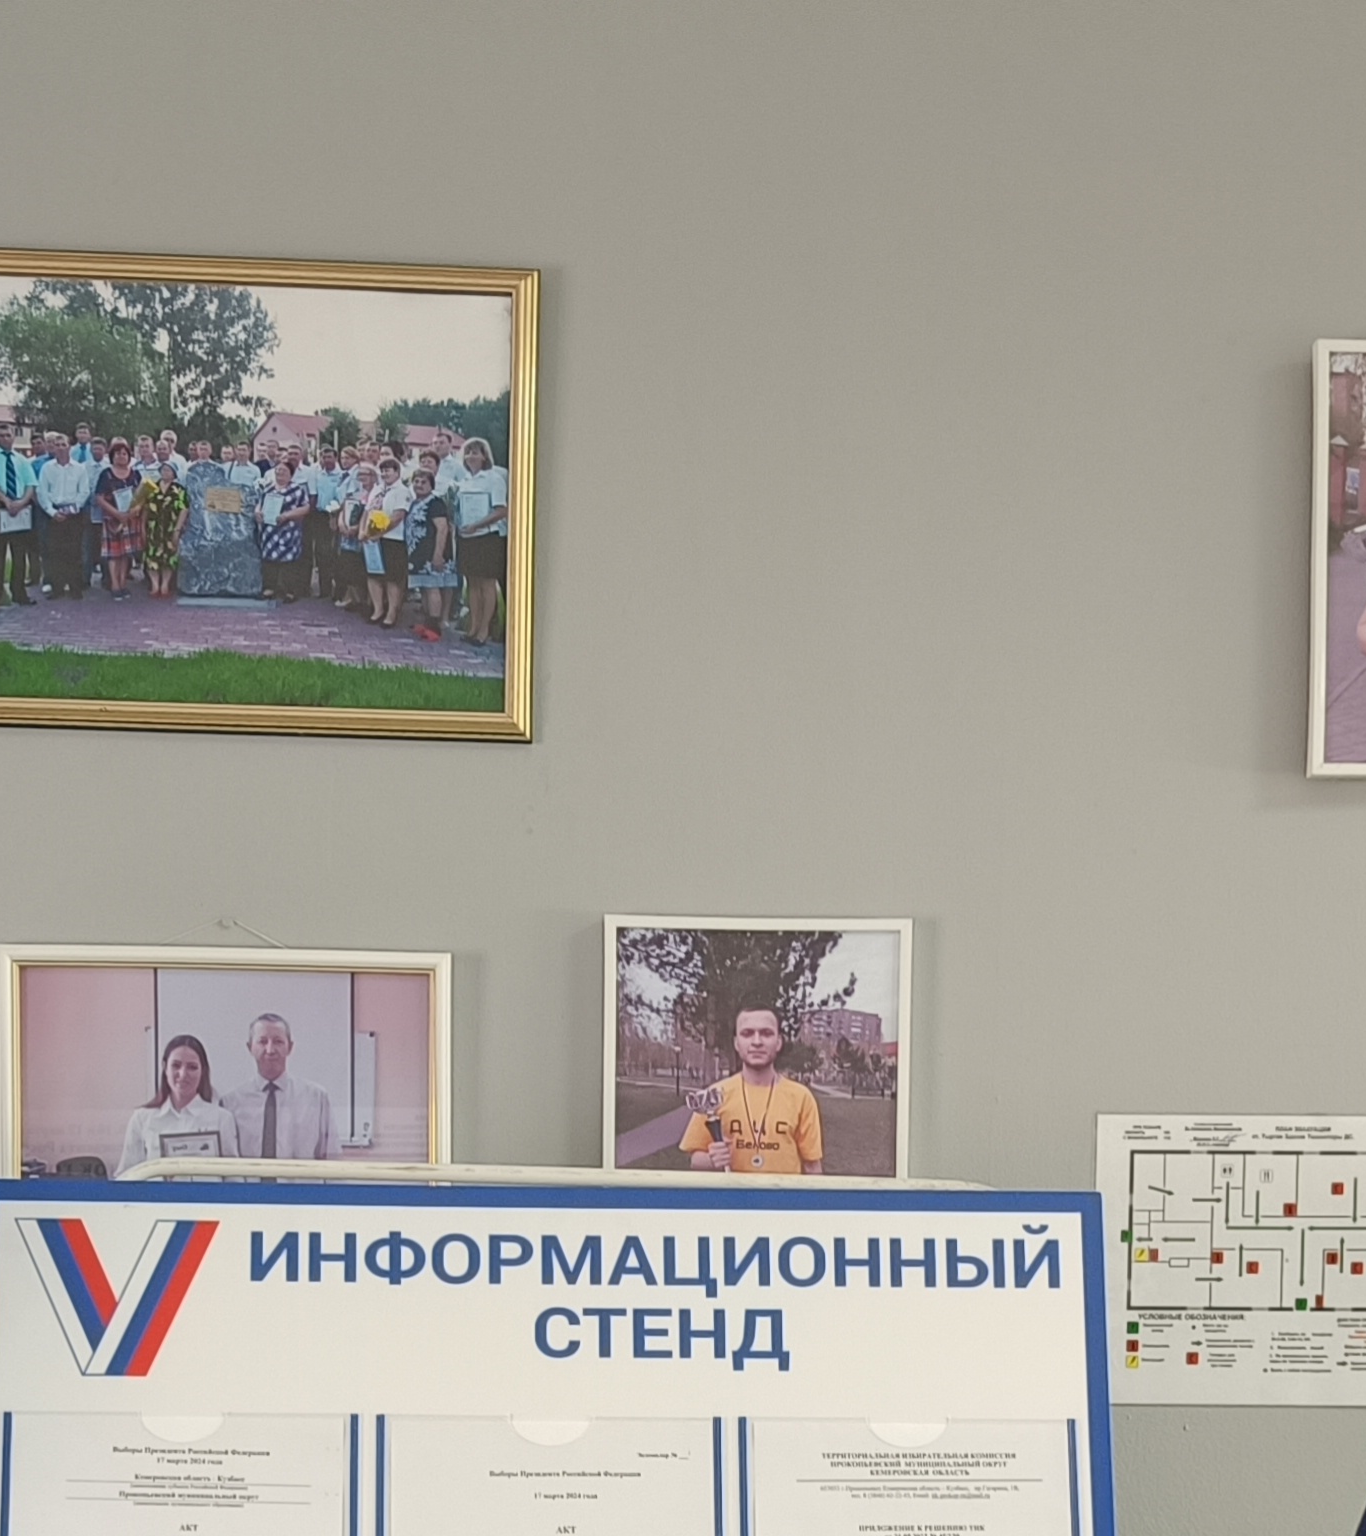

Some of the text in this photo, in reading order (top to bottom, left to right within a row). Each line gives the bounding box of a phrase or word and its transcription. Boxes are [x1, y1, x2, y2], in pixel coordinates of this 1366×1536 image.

[248, 1224, 1062, 1297] ИНФОРМАЦИОННЫЙ
[1137, 1313, 1183, 1321] УСЛОВНЫЕ
[533, 1307, 791, 1370] СТЕНД
[821, 1452, 901, 1460] ТЕРРИТОРИАЛЬНАЯ
[179, 1524, 198, 1532] АКТ
[556, 1525, 576, 1534] АКТ
